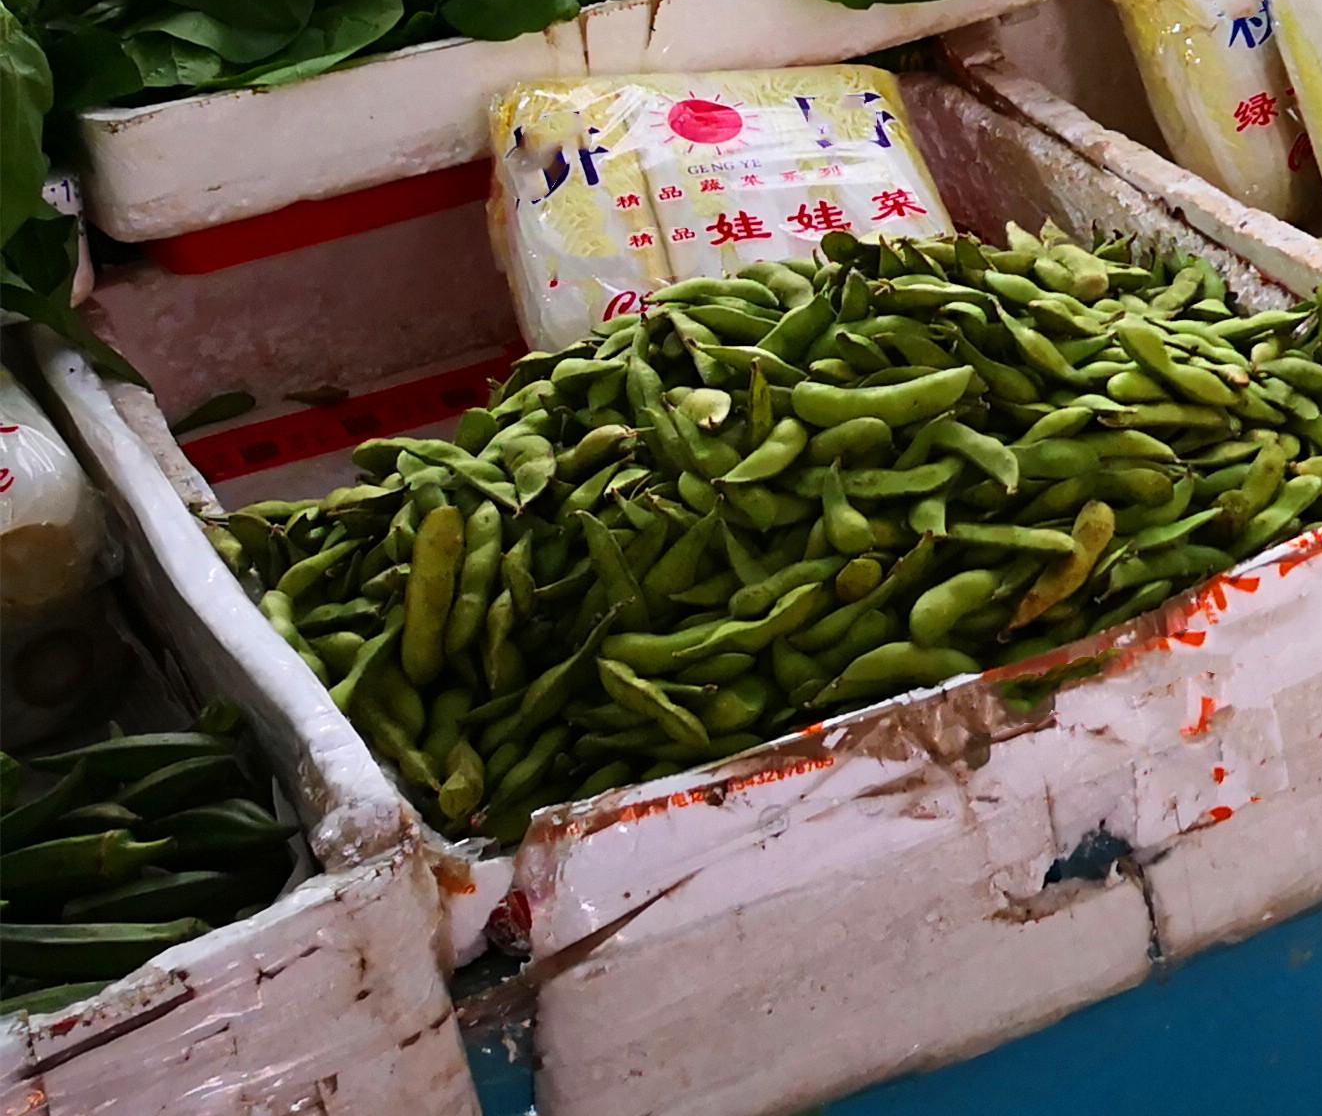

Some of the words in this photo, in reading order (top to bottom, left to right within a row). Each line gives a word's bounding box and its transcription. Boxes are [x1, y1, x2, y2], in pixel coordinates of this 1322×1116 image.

[687, 160, 735, 176] GENG
[739, 158, 763, 172] YE
[616, 164, 844, 211] 精品蔬菜系列
